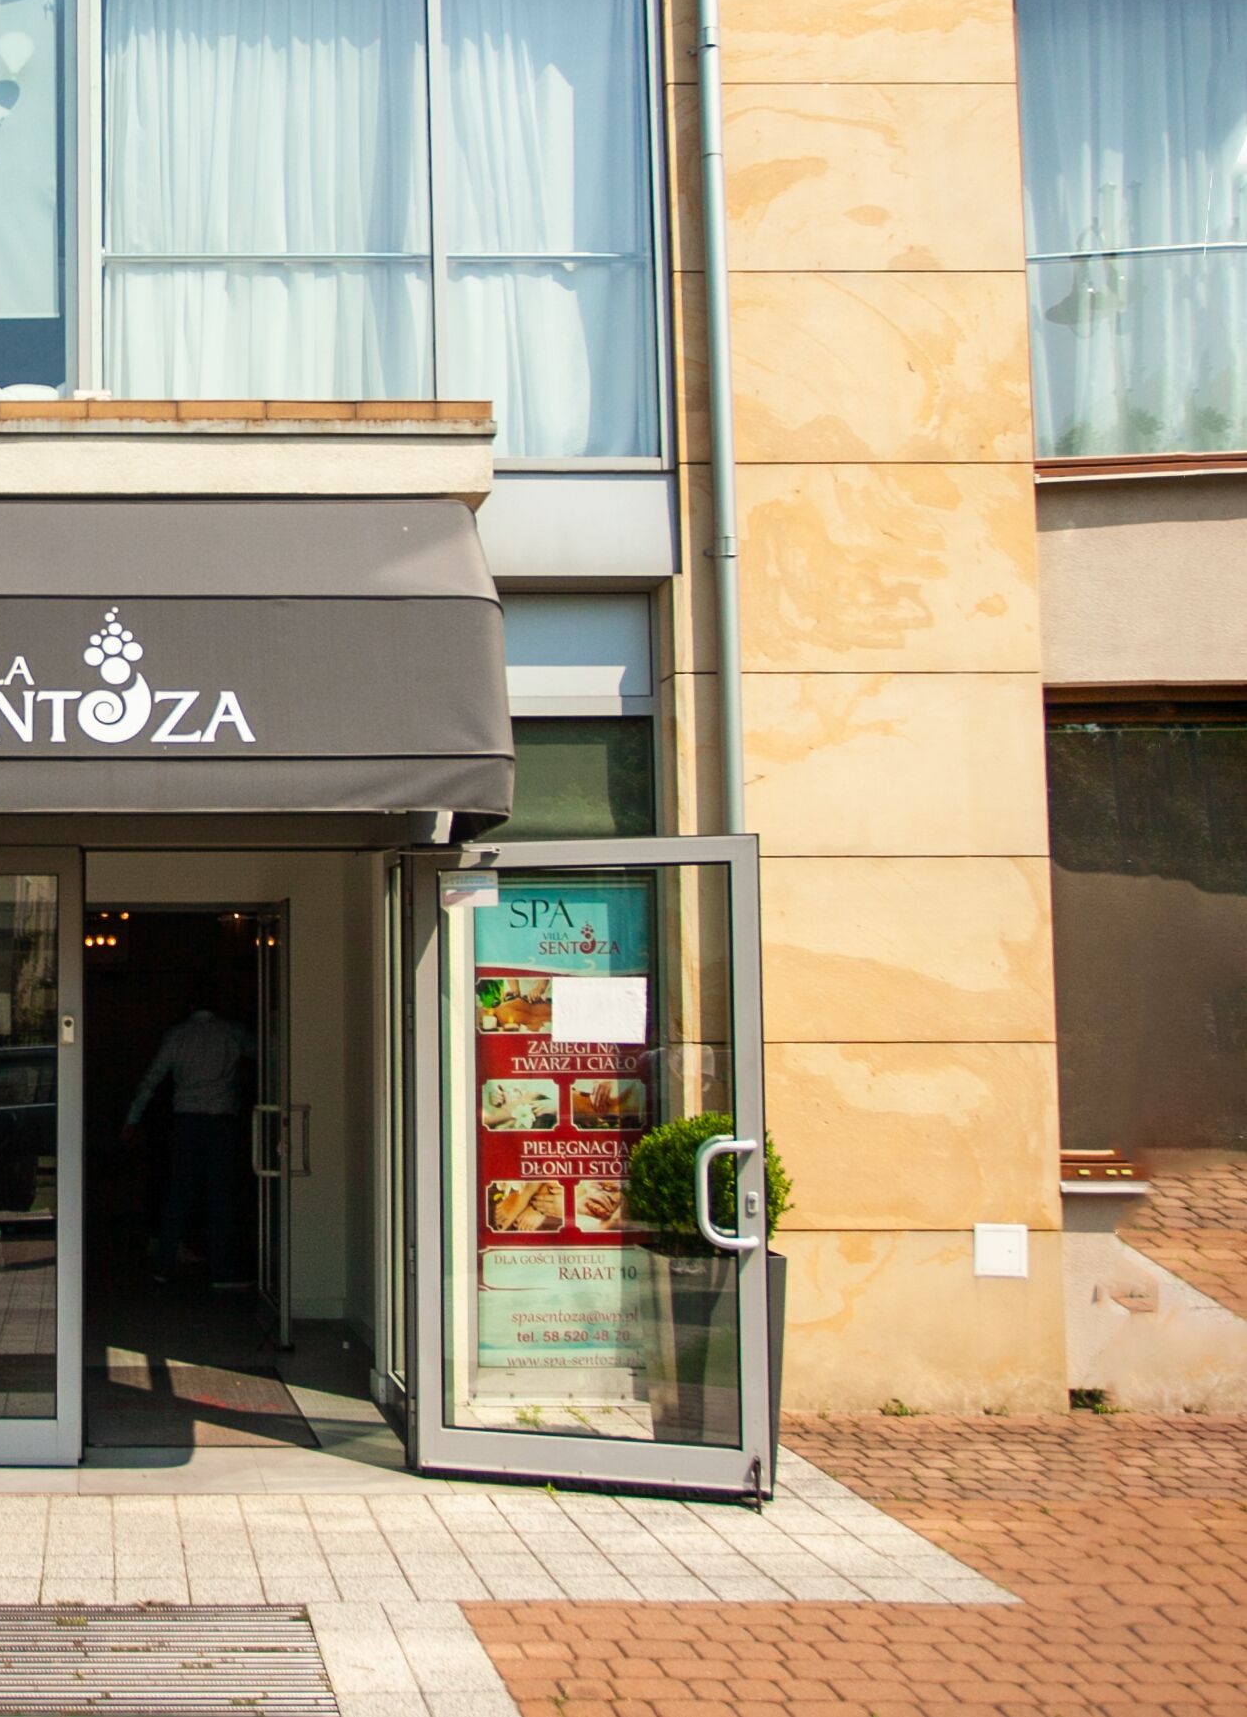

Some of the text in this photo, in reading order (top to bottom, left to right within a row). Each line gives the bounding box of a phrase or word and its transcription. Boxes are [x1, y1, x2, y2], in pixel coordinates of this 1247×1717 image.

[509, 898, 574, 928] SPA
[542, 932, 569, 940] VILLA
[539, 940, 621, 955] SENTOZA
[527, 1041, 620, 1054] ZABIEGI NA
[511, 1057, 637, 1071] TWARZ I CIAŁO
[522, 1141, 629, 1159] PIELĘGNACJA
[521, 1161, 573, 1176] DŁONI
[578, 1161, 584, 1175] I
[494, 1253, 606, 1265] DLA GOŚCI HOTELU
[558, 1266, 637, 1281] RABAT 10
[517, 1330, 539, 1343] tel.
[543, 1331, 560, 1342] 58
[564, 1331, 589, 1342] 520
